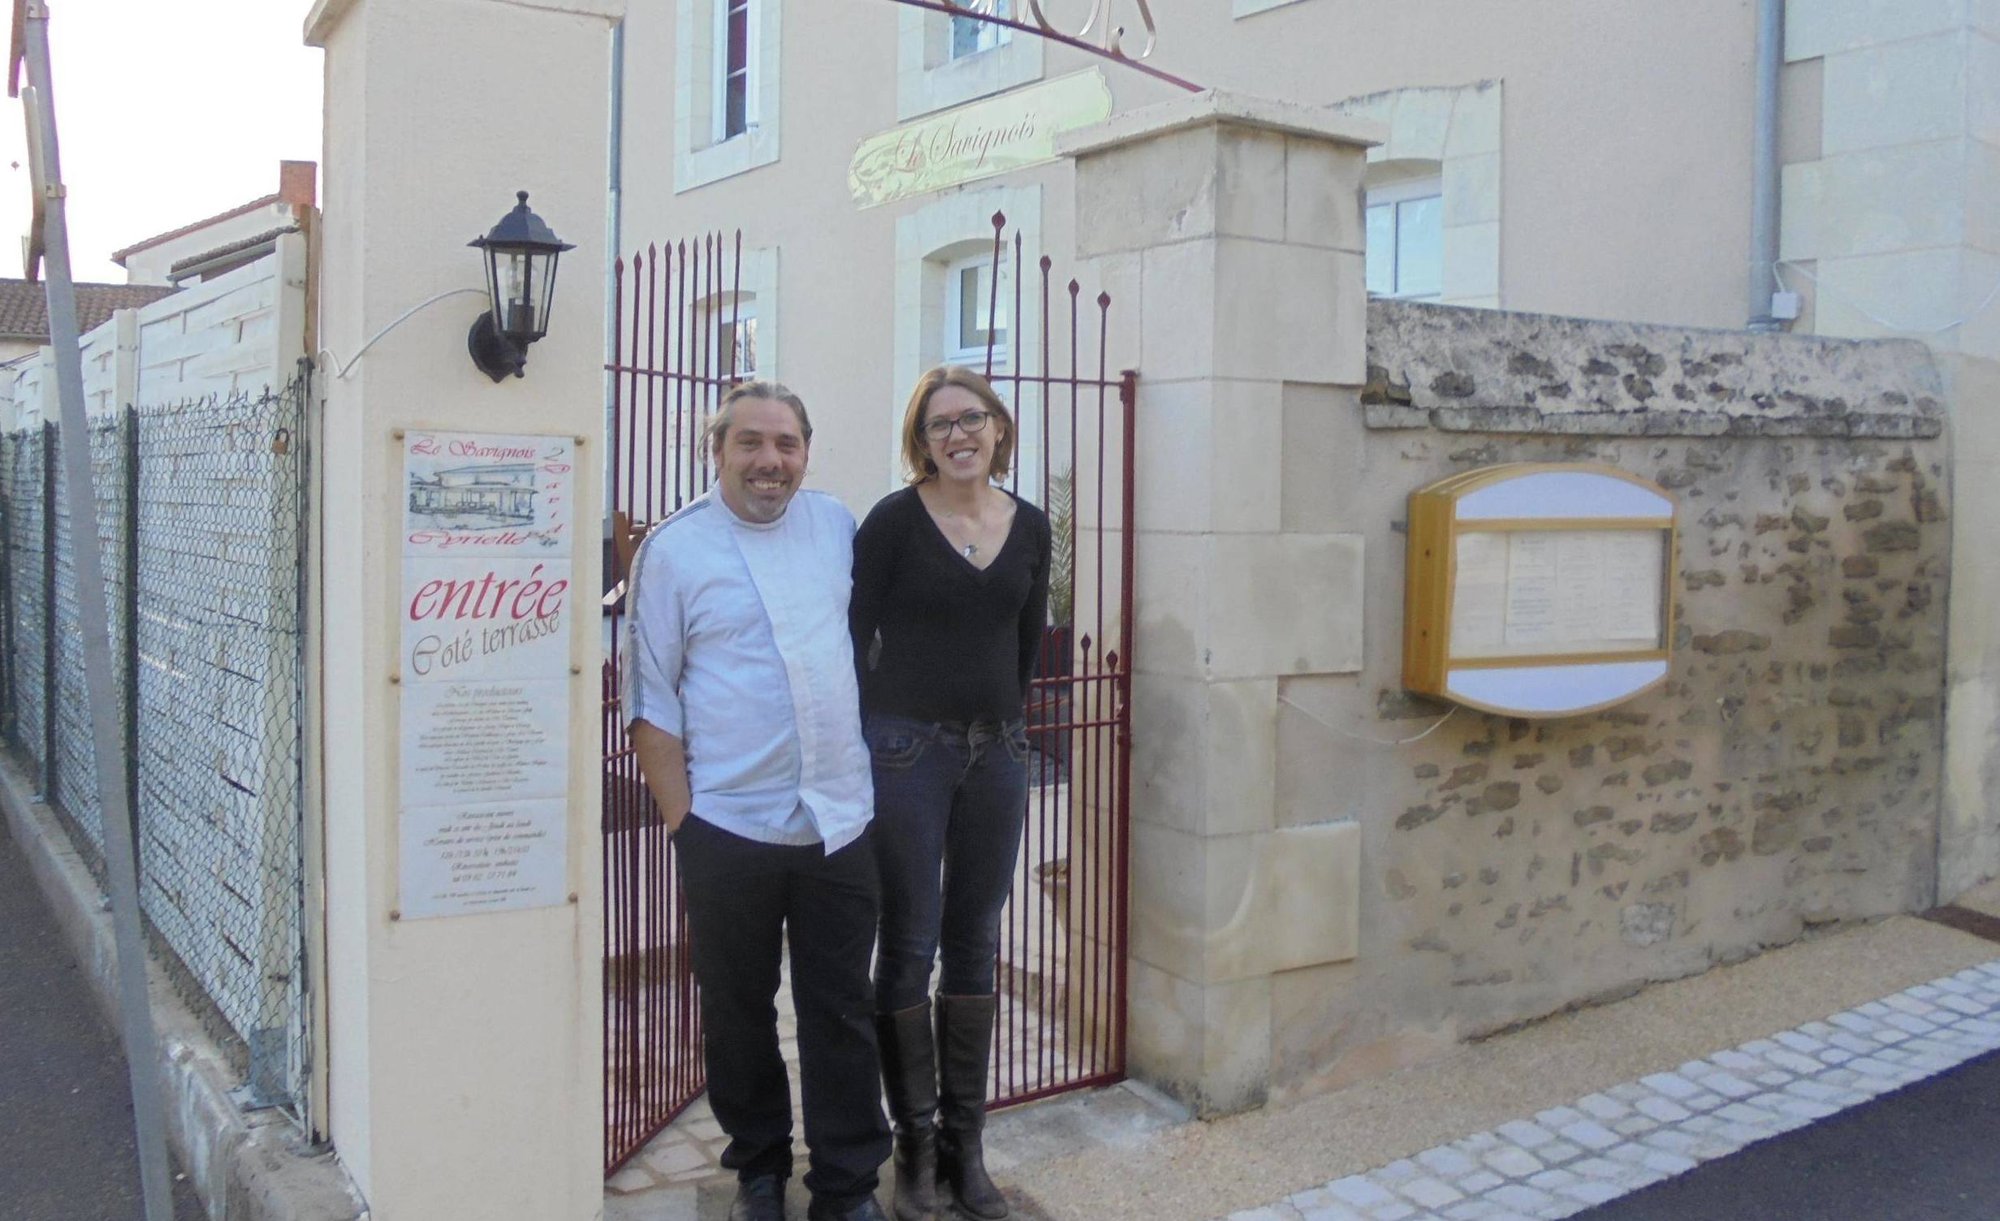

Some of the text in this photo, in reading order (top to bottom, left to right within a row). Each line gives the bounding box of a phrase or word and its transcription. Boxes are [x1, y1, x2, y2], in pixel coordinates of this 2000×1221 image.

[929, 113, 1037, 168] Savignois
[410, 436, 537, 464] Le Savignois
[409, 563, 568, 621] entrée
[412, 610, 561, 675] Coté terrasse
